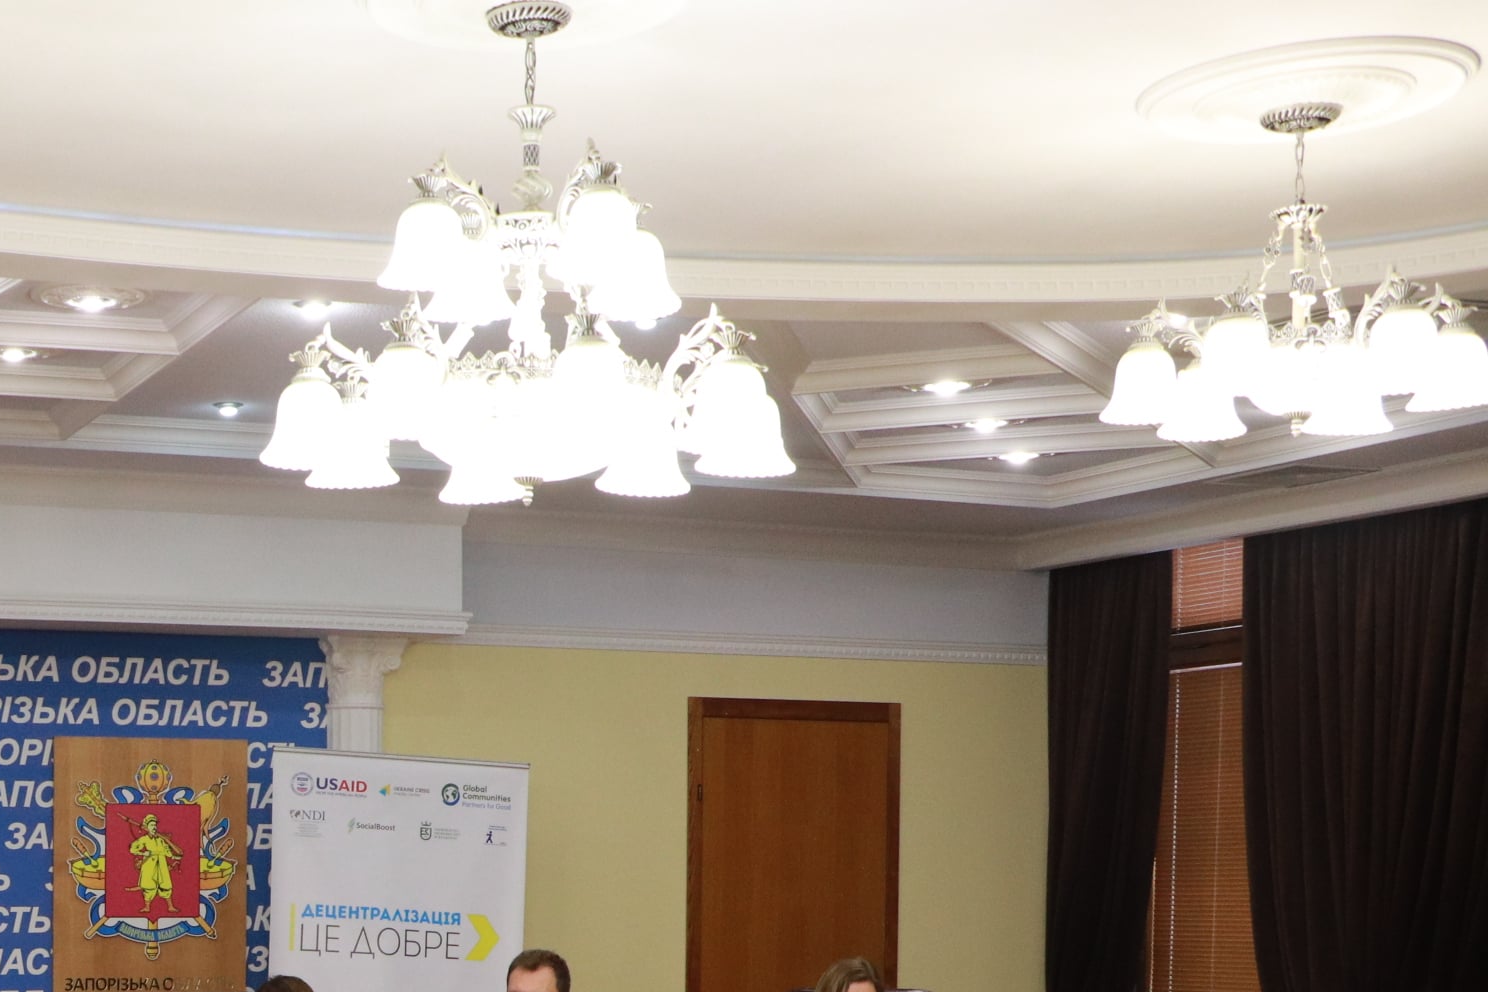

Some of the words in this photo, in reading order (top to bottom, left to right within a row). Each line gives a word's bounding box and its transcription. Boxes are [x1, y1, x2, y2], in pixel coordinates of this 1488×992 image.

[72, 655, 230, 686] ОБЛАСТЬ
[112, 698, 268, 728] ОБЛАСТЬ
[316, 777, 368, 794] USAID
[463, 784, 487, 793] Global
[462, 793, 511, 803] Communities
[302, 810, 326, 821] NDI
[356, 822, 396, 832] SocialBoost
[4, 822, 54, 850] ЗА
[301, 903, 461, 926] ДЕЦЕНТРАЛІЗАЦІЯ
[300, 924, 341, 957] ЦЕ
[350, 926, 462, 960] ДОБРЕ
[65, 977, 160, 992] ЗАПОРІЗЬКА
